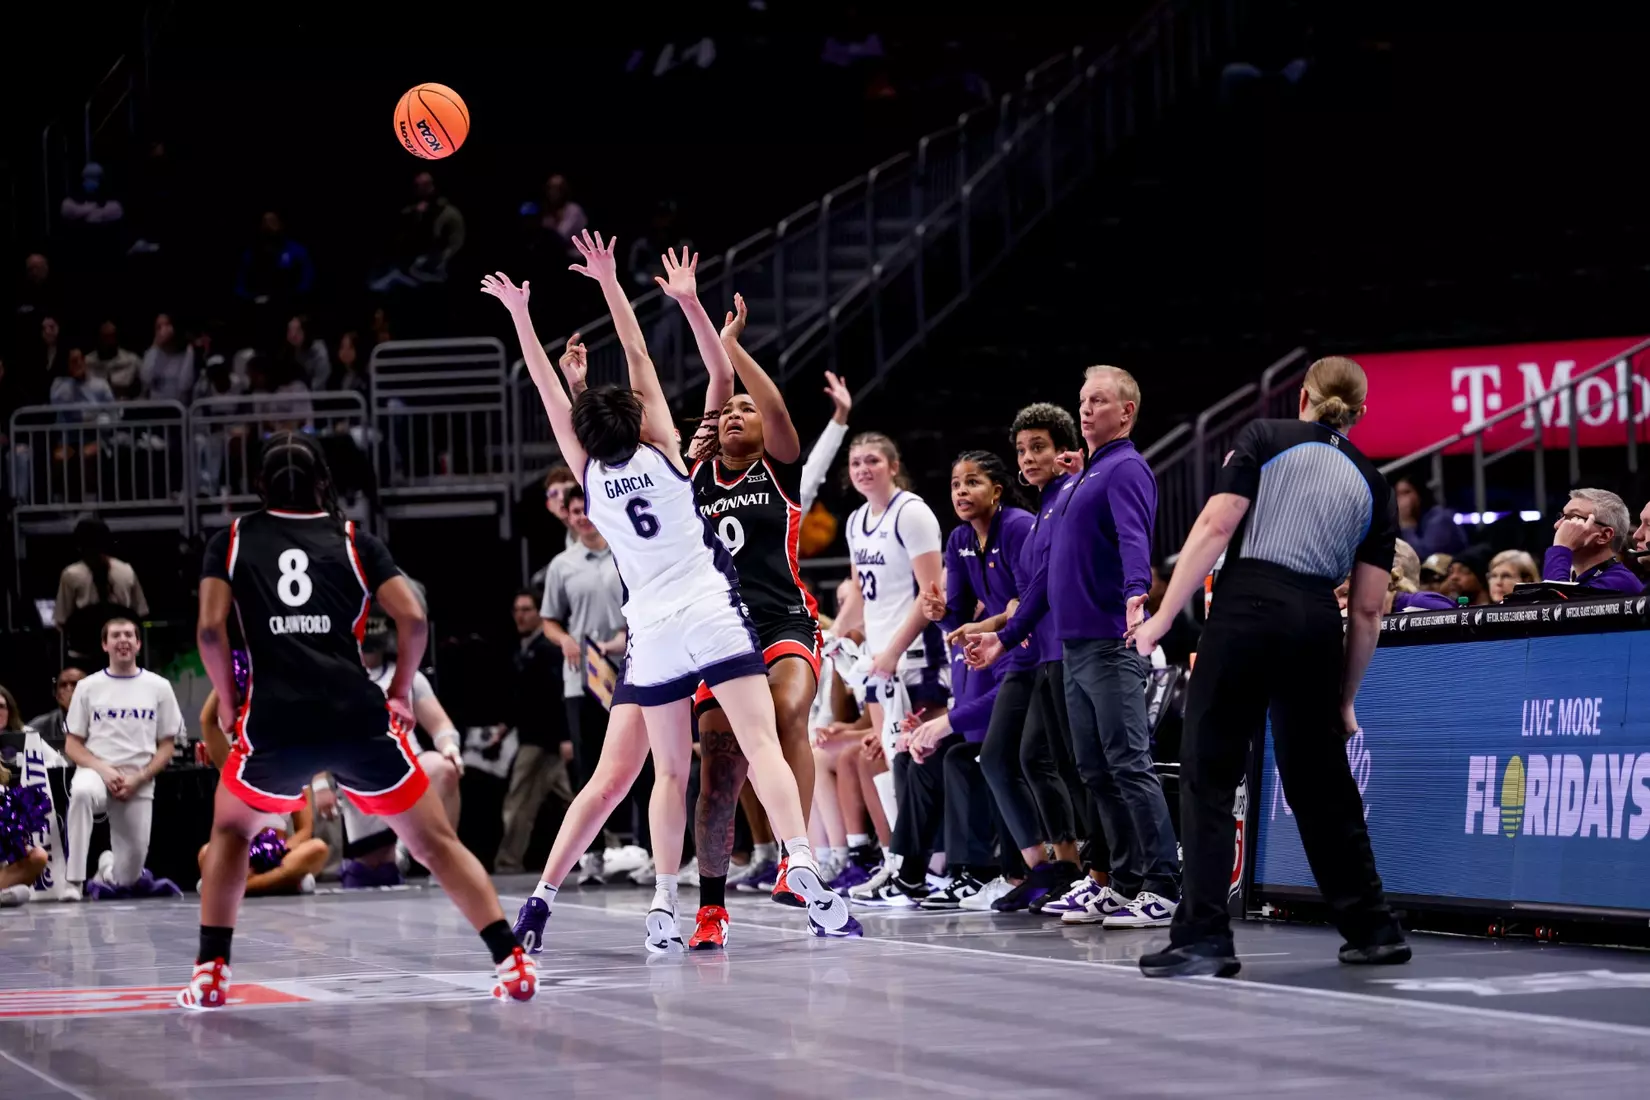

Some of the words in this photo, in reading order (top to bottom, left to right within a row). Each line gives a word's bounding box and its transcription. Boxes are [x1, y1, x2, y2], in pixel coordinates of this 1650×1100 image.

[416, 119, 443, 151] NCAA
[605, 473, 655, 499] GARCIA
[700, 493, 769, 515] INCINNATI
[625, 496, 661, 540] 6
[719, 516, 745, 557] 9
[277, 548, 313, 607] 8
[269, 614, 331, 635] CRAWFORD
[1521, 699, 1554, 737] LIVE
[1557, 697, 1603, 736] MORE
